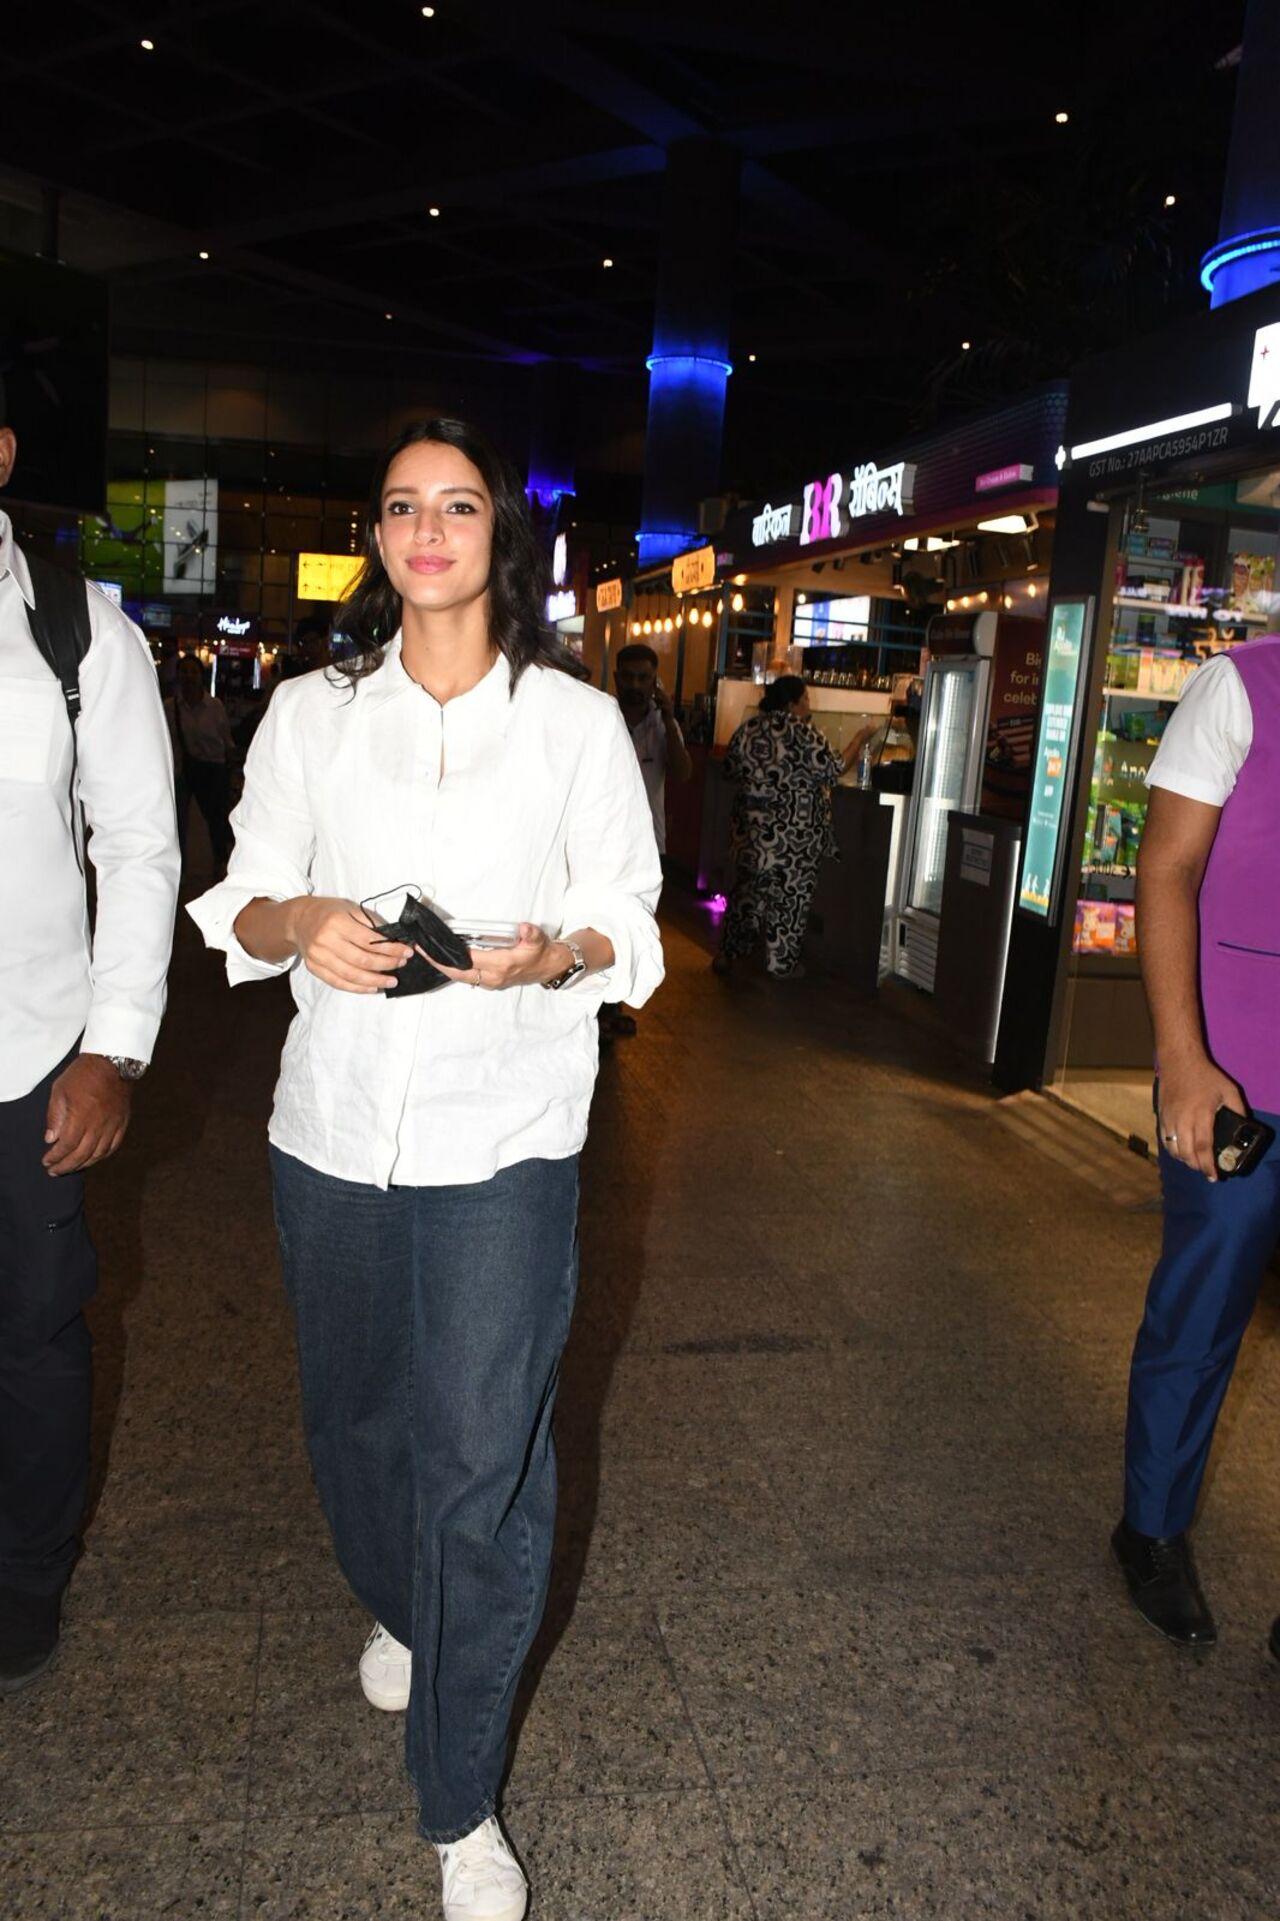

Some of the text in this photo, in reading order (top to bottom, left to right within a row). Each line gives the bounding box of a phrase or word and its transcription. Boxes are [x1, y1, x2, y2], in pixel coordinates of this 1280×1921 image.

[1088, 459, 1108, 478] GST
[799, 472, 843, 547] BR
[1010, 670, 1030, 684] for
